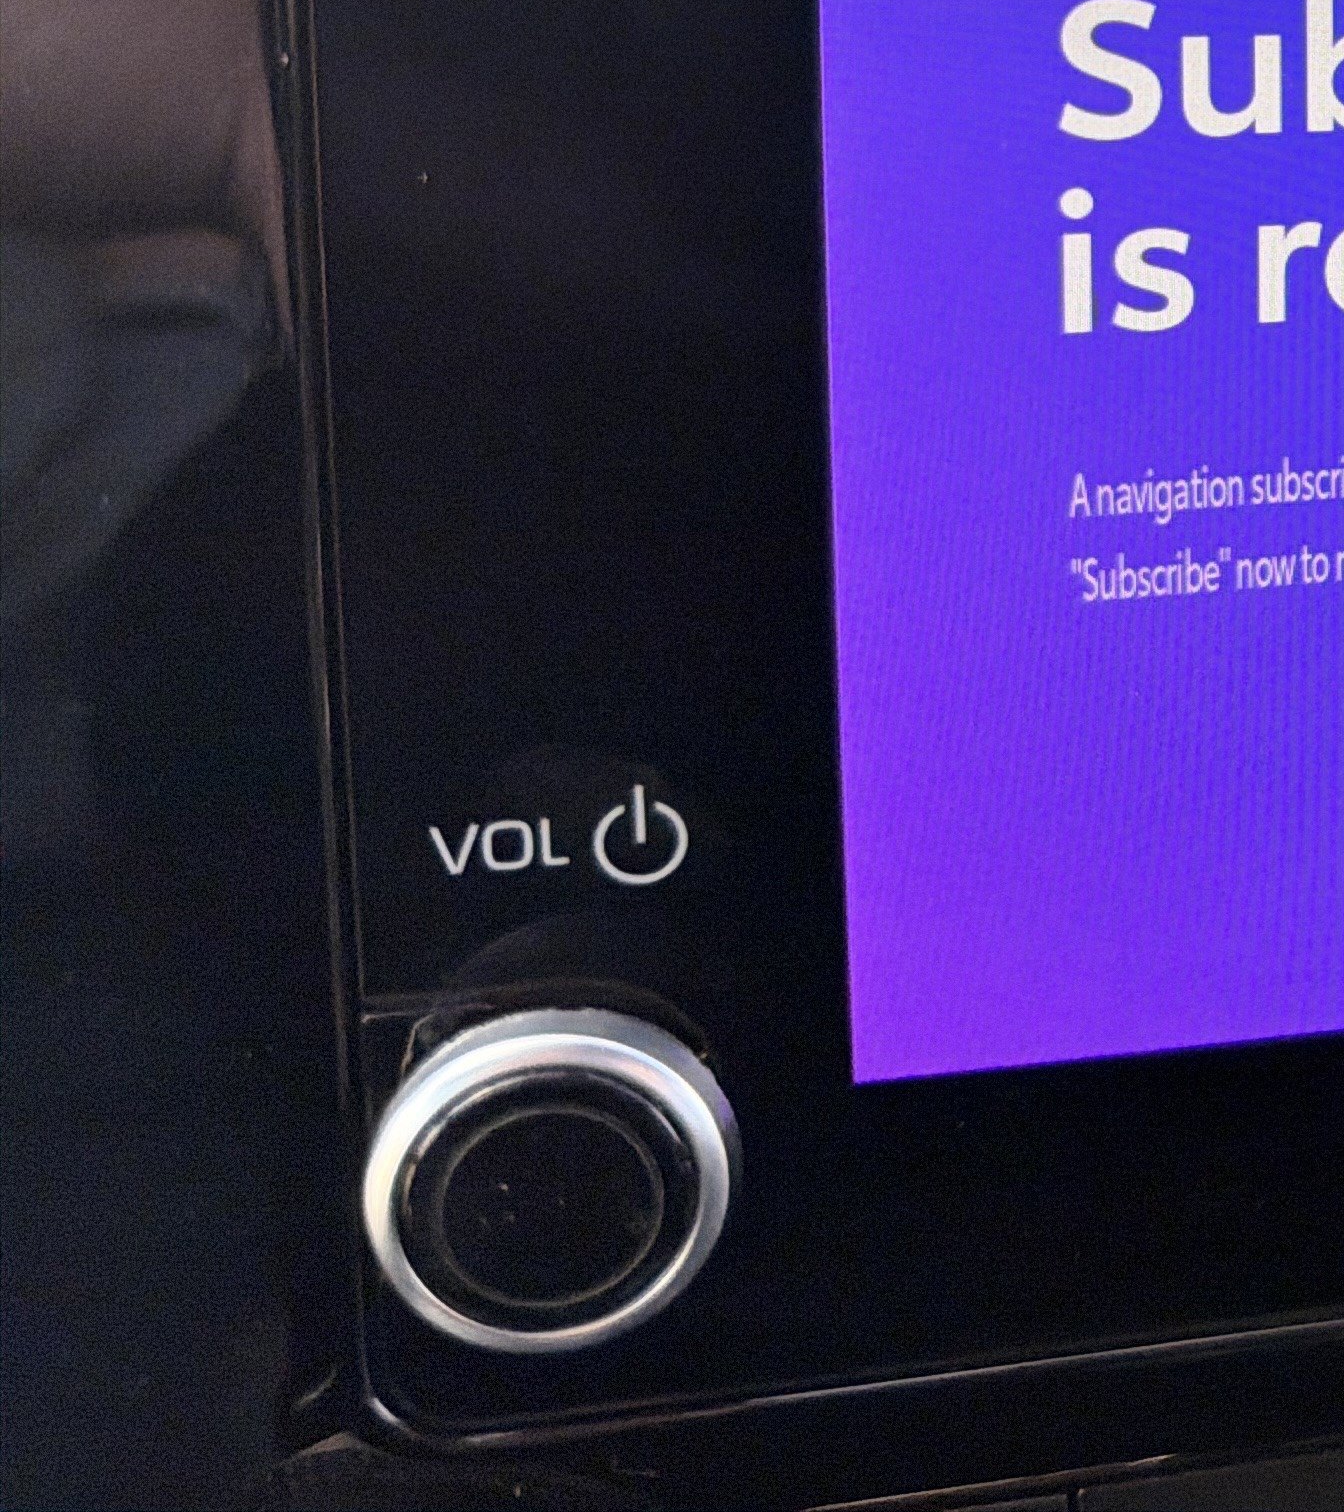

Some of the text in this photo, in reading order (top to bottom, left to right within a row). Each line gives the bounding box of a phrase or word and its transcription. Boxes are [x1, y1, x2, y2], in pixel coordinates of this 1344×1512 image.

[1059, 186, 1196, 333] is
[1068, 471, 1091, 518] A
[1095, 464, 1245, 525] navigation
[1070, 546, 1232, 603] "Subscribe"
[1236, 552, 1297, 591] now
[1300, 544, 1329, 584] to
[428, 817, 570, 877] VOL
